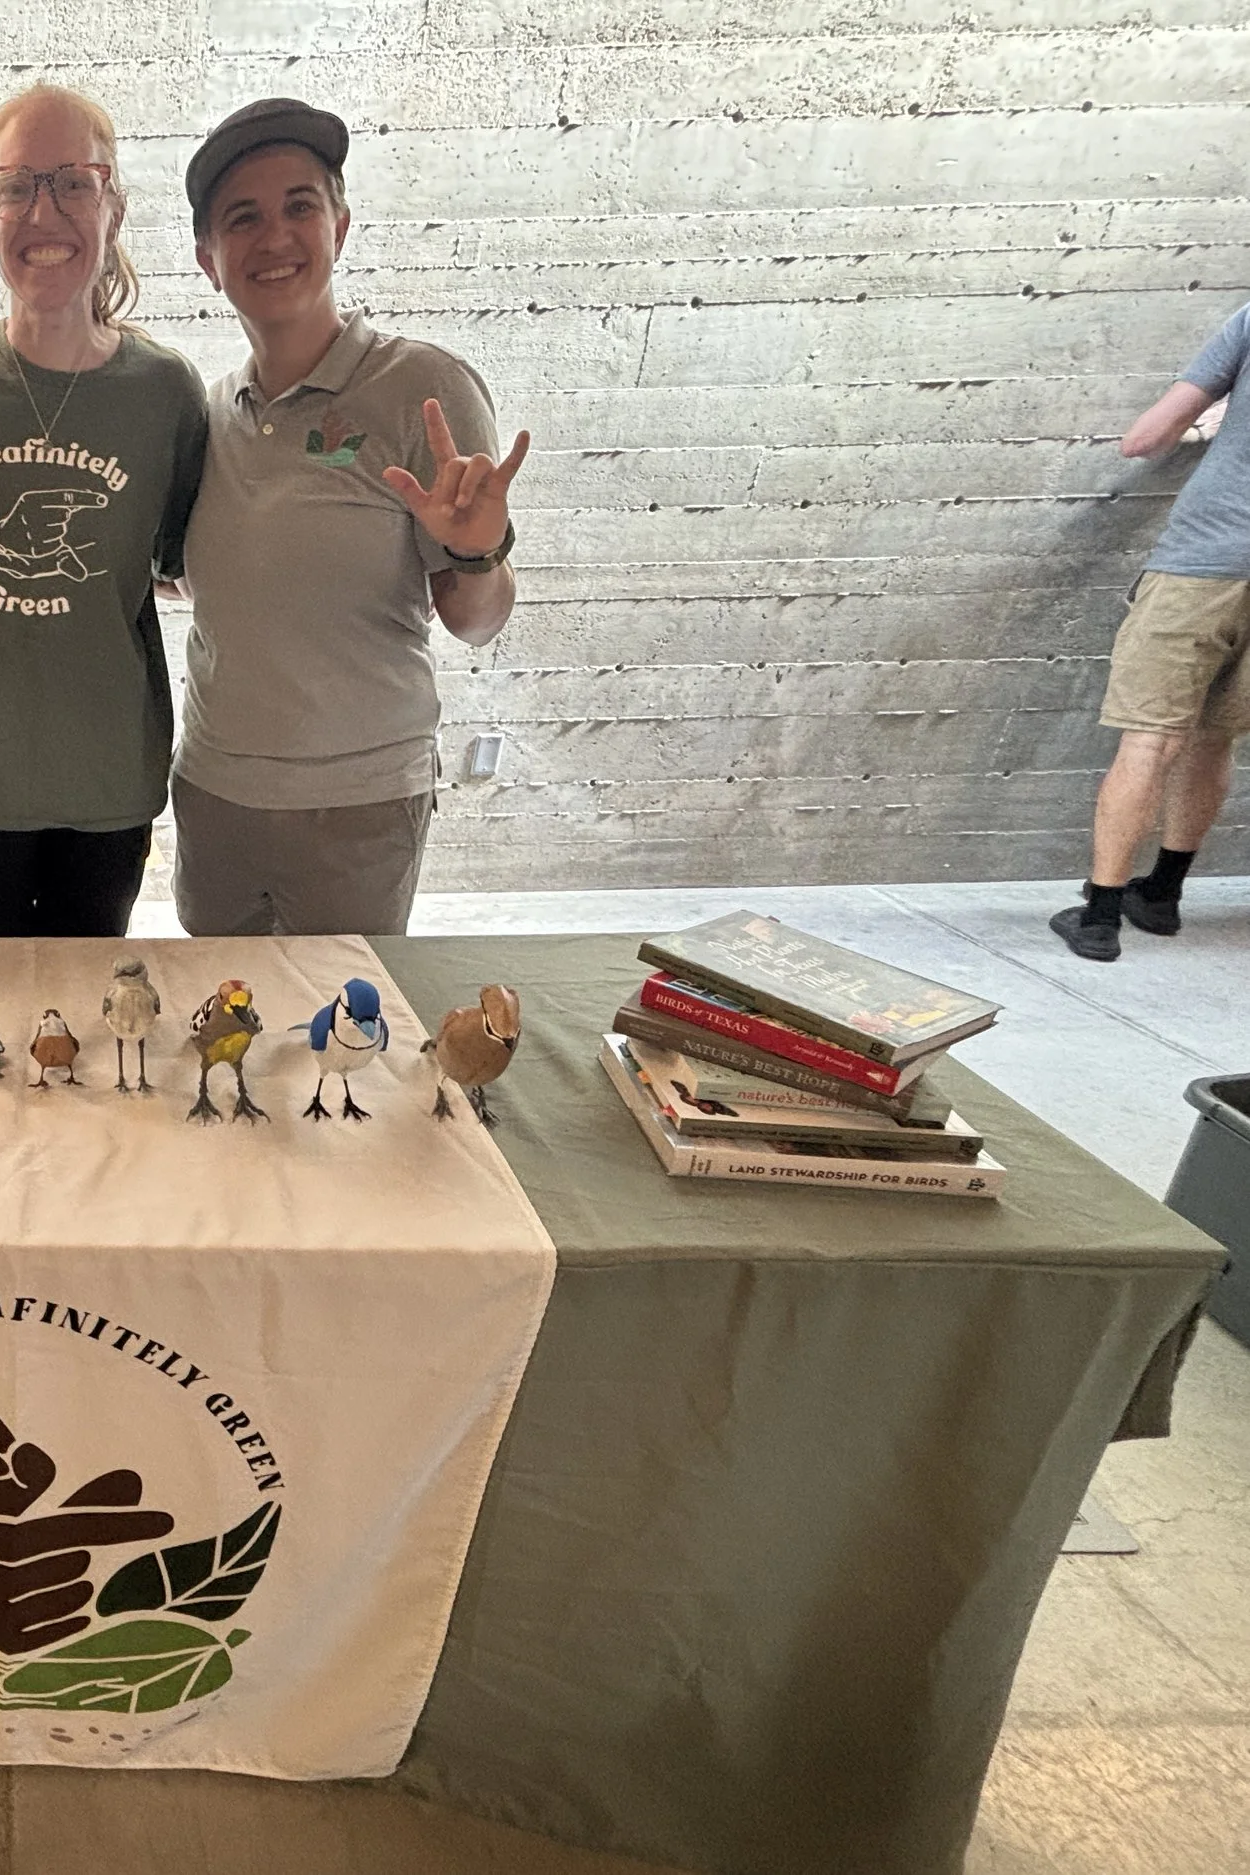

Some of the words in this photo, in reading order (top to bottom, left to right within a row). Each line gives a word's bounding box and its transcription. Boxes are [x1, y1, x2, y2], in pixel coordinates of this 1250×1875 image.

[655, 992, 694, 1015] BIRDS
[705, 1011, 750, 1034] TEXAS
[683, 1040, 749, 1067] NATURE'S
[754, 1059, 792, 1081] BEST
[797, 1071, 841, 1094] HOPE
[737, 1089, 793, 1104] nature's
[729, 1164, 765, 1176] LAND
[769, 1166, 868, 1182] STEWARDSHIP
[871, 1173, 900, 1184] FOR
[905, 1176, 949, 1188] BIRDS
[205, 1391, 286, 1492] GREEN
